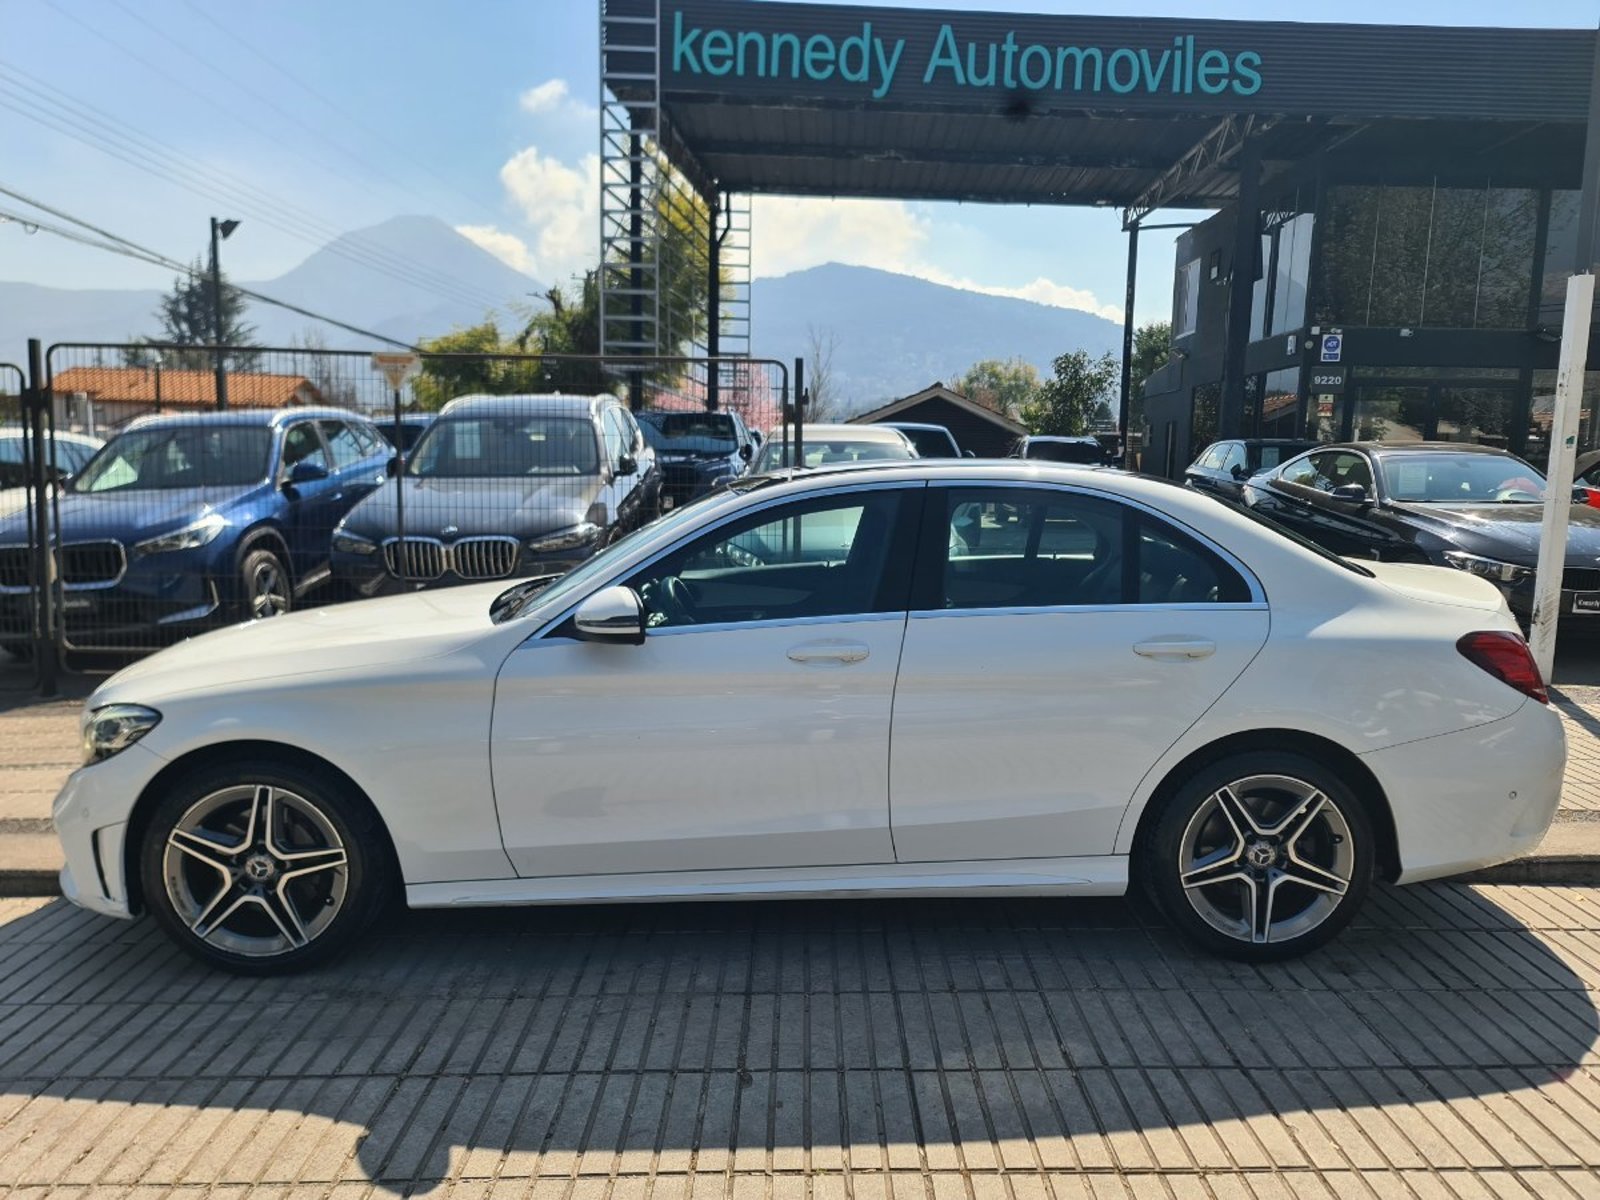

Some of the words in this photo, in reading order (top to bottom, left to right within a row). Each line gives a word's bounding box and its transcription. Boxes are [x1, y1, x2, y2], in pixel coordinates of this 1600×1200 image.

[672, 10, 906, 100] kennedy
[922, 25, 1264, 97] Automoviles
[1314, 375, 1342, 385] 9220
